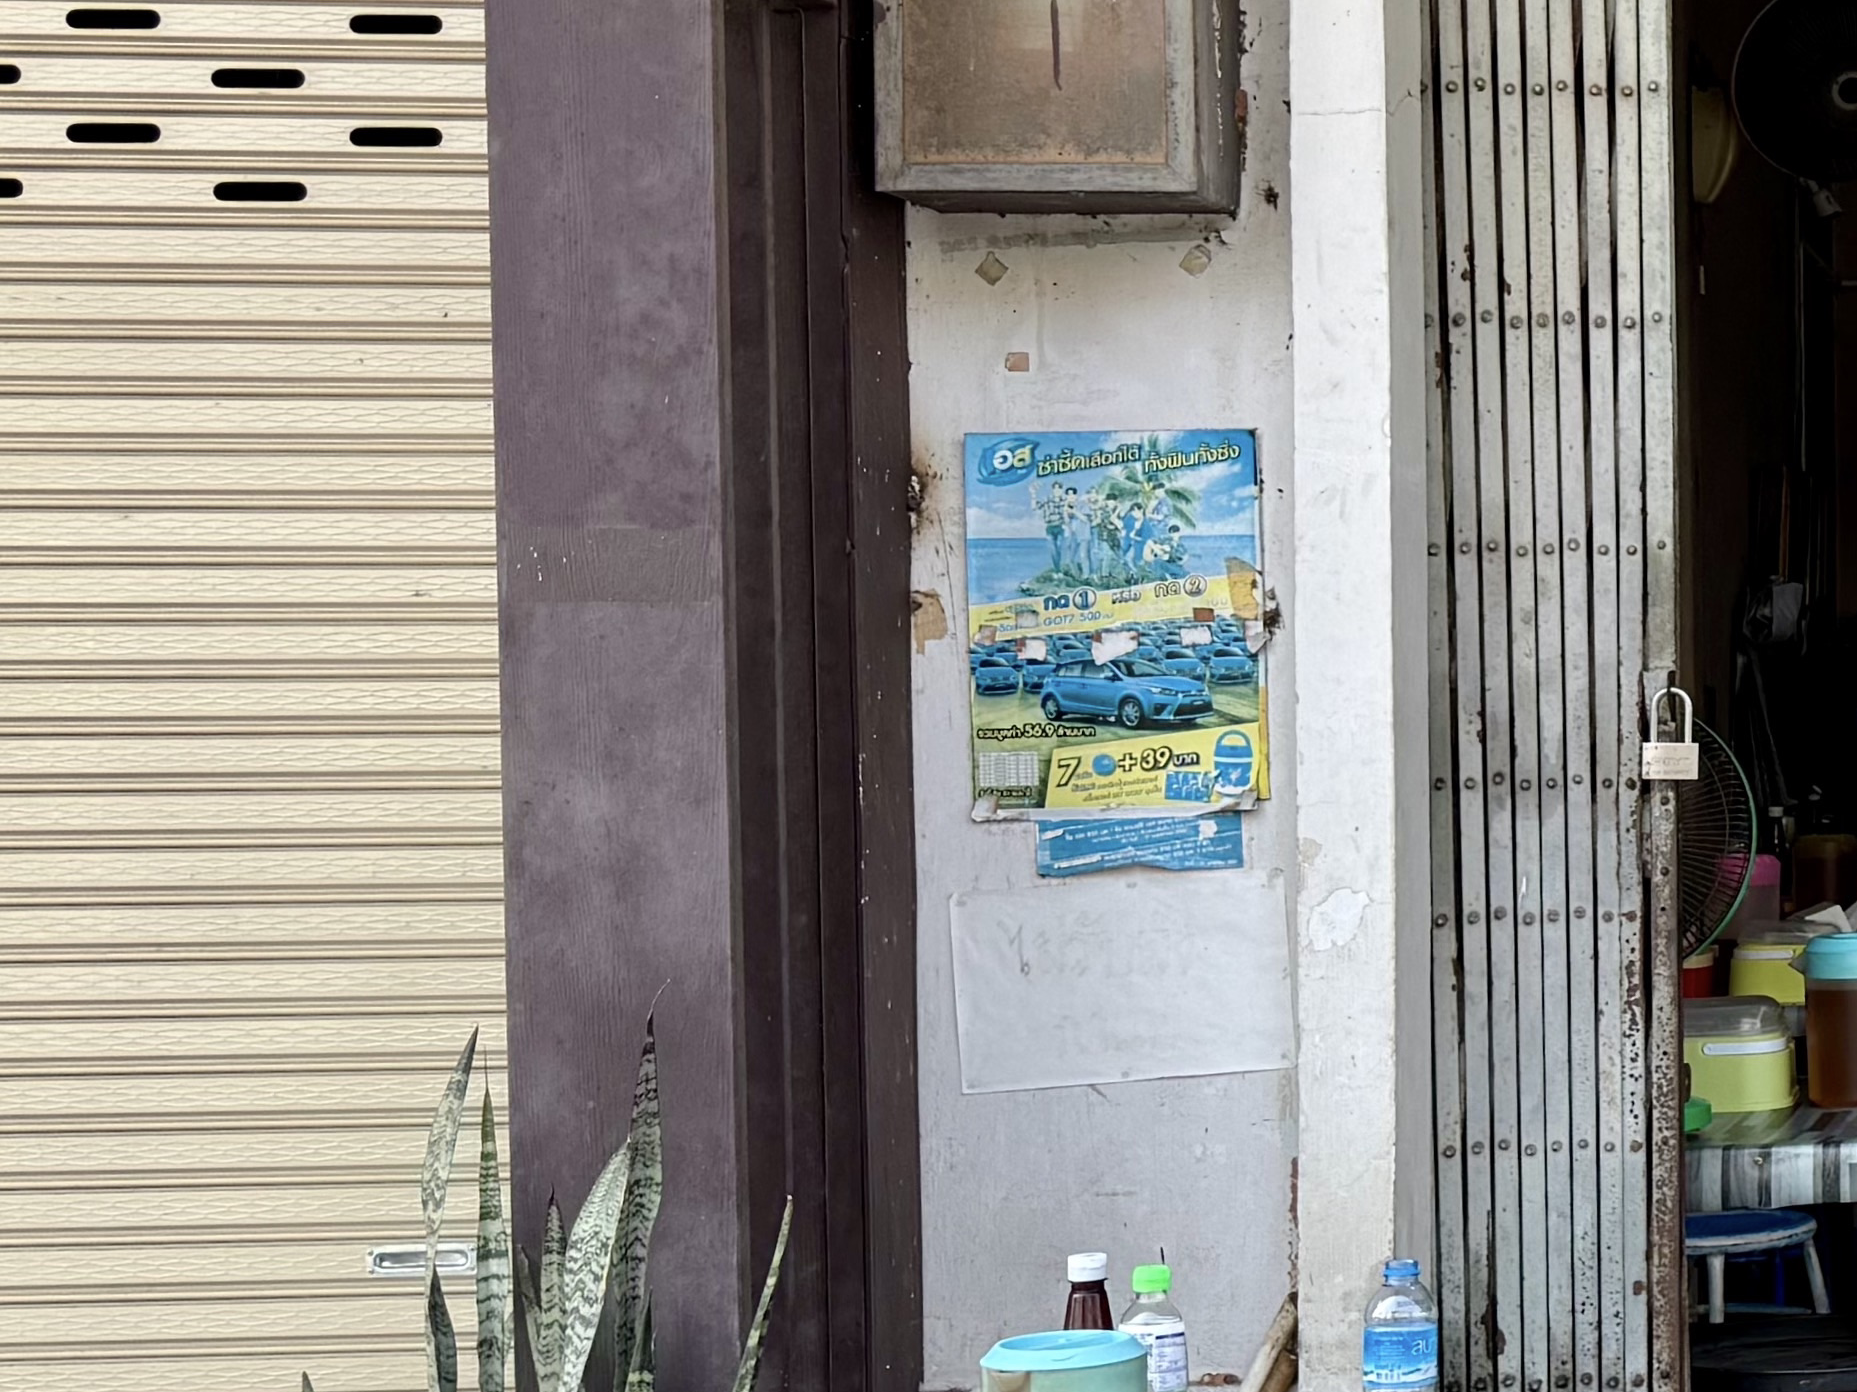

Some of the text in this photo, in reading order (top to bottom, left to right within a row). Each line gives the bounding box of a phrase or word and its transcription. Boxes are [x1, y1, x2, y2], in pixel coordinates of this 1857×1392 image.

[1023, 722, 1056, 739] 56.9
[1055, 755, 1082, 788] 7
[1140, 745, 1173, 772] 39
